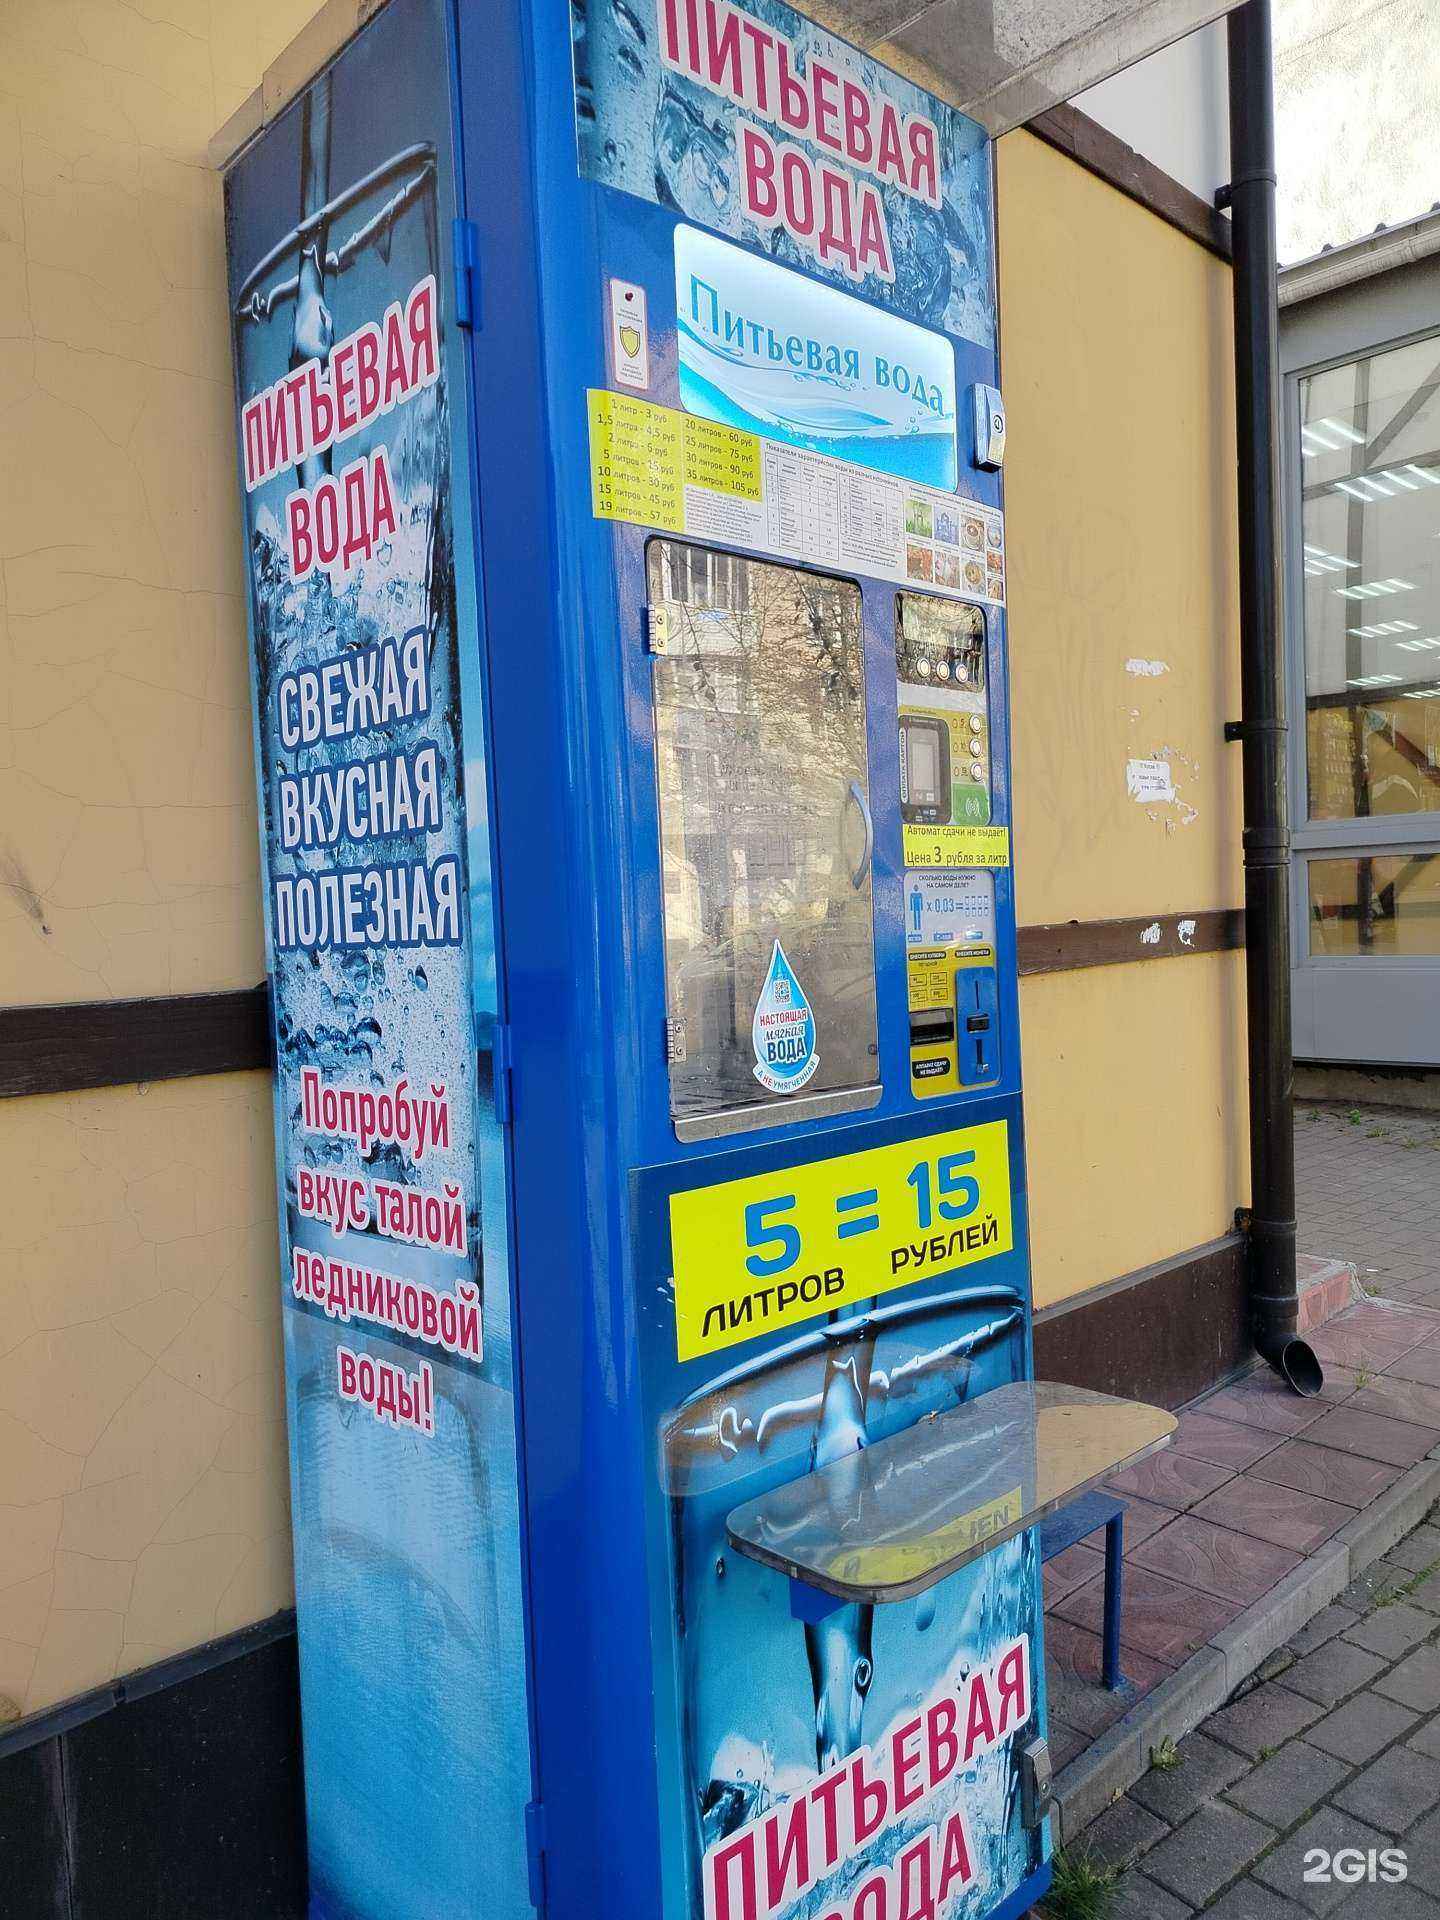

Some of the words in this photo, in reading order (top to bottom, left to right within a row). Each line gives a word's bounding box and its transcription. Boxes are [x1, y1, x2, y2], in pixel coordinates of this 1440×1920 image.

[661, 0, 937, 200] ПИТЬЕВАЯ
[742, 127, 891, 275] ВОДА
[245, 285, 436, 485] ПИТЬЕВАЯ
[690, 273, 861, 381] Питьевая
[874, 355, 944, 417] вода
[289, 454, 397, 577] ВОДА
[279, 633, 428, 747] СВЕЖАЯ
[281, 747, 441, 849] ВКУСНАЯ
[907, 826, 940, 836] Автомат
[942, 828, 965, 838] сдачи
[967, 828, 977, 837] не
[276, 861, 460, 946] ПОЛЕЗНАЯ
[906, 850, 931, 866] Цена
[933, 846, 942, 863] 3
[946, 851, 973, 866] рубля
[976, 855, 985, 863] за
[987, 855, 1008, 866] литр
[934, 898, 954, 914] 0,03
[759, 1008, 808, 1027] НАСТОЯЩАЯ
[764, 1025, 805, 1042] мягкая
[766, 1037, 806, 1063] ВОДА
[303, 1071, 449, 1160] Попробуй
[757, 1069, 763, 1080] А
[762, 1074, 773, 1087] НЕ
[299, 1170, 366, 1234] вкус
[375, 1183, 465, 1250] талой
[745, 1194, 801, 1277] 5
[907, 1150, 980, 1229] 15
[294, 1250, 479, 1356] ледниковой
[701, 1266, 846, 1338] ЛИТРОВ
[891, 1213, 999, 1275] РУБЛЕЙ
[340, 1352, 432, 1430] воды!
[712, 1642, 1027, 1920] ПИТЬЕВАЯ
